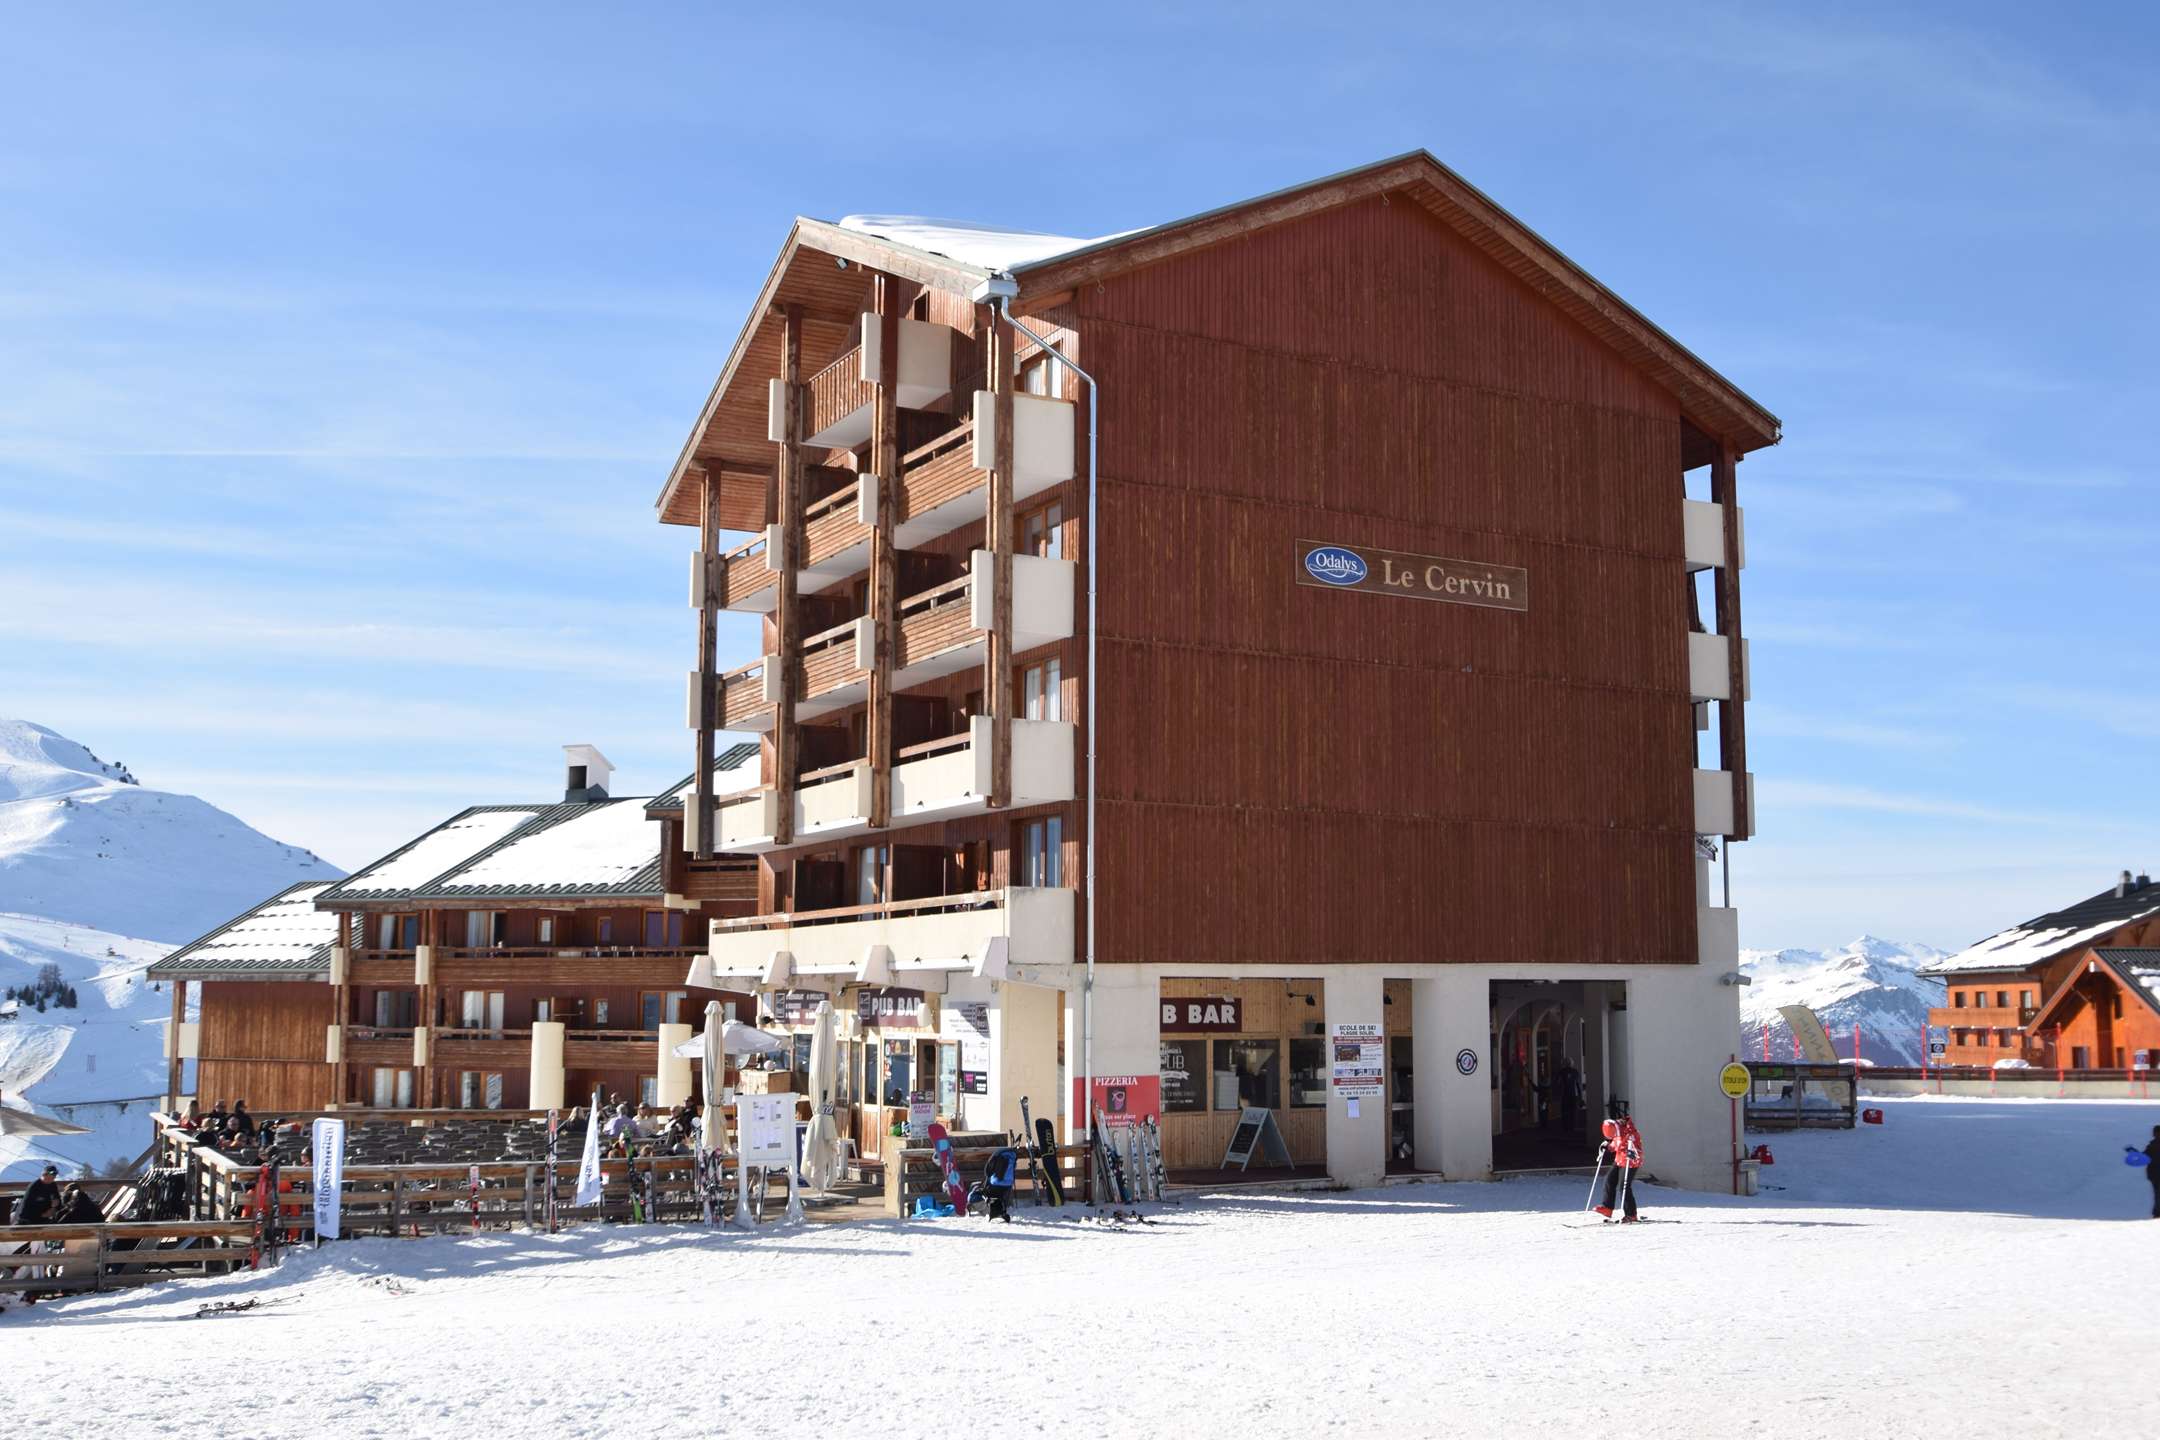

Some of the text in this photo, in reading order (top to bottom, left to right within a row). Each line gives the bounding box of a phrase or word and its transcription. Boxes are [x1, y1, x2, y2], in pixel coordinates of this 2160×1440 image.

[1315, 552, 1358, 573] Odalys
[1382, 560, 1512, 600] Le Cervin
[871, 997, 893, 1016] PUB
[1188, 1004, 1236, 1024] BAR
[1095, 1077, 1138, 1086] PIZZERIA
